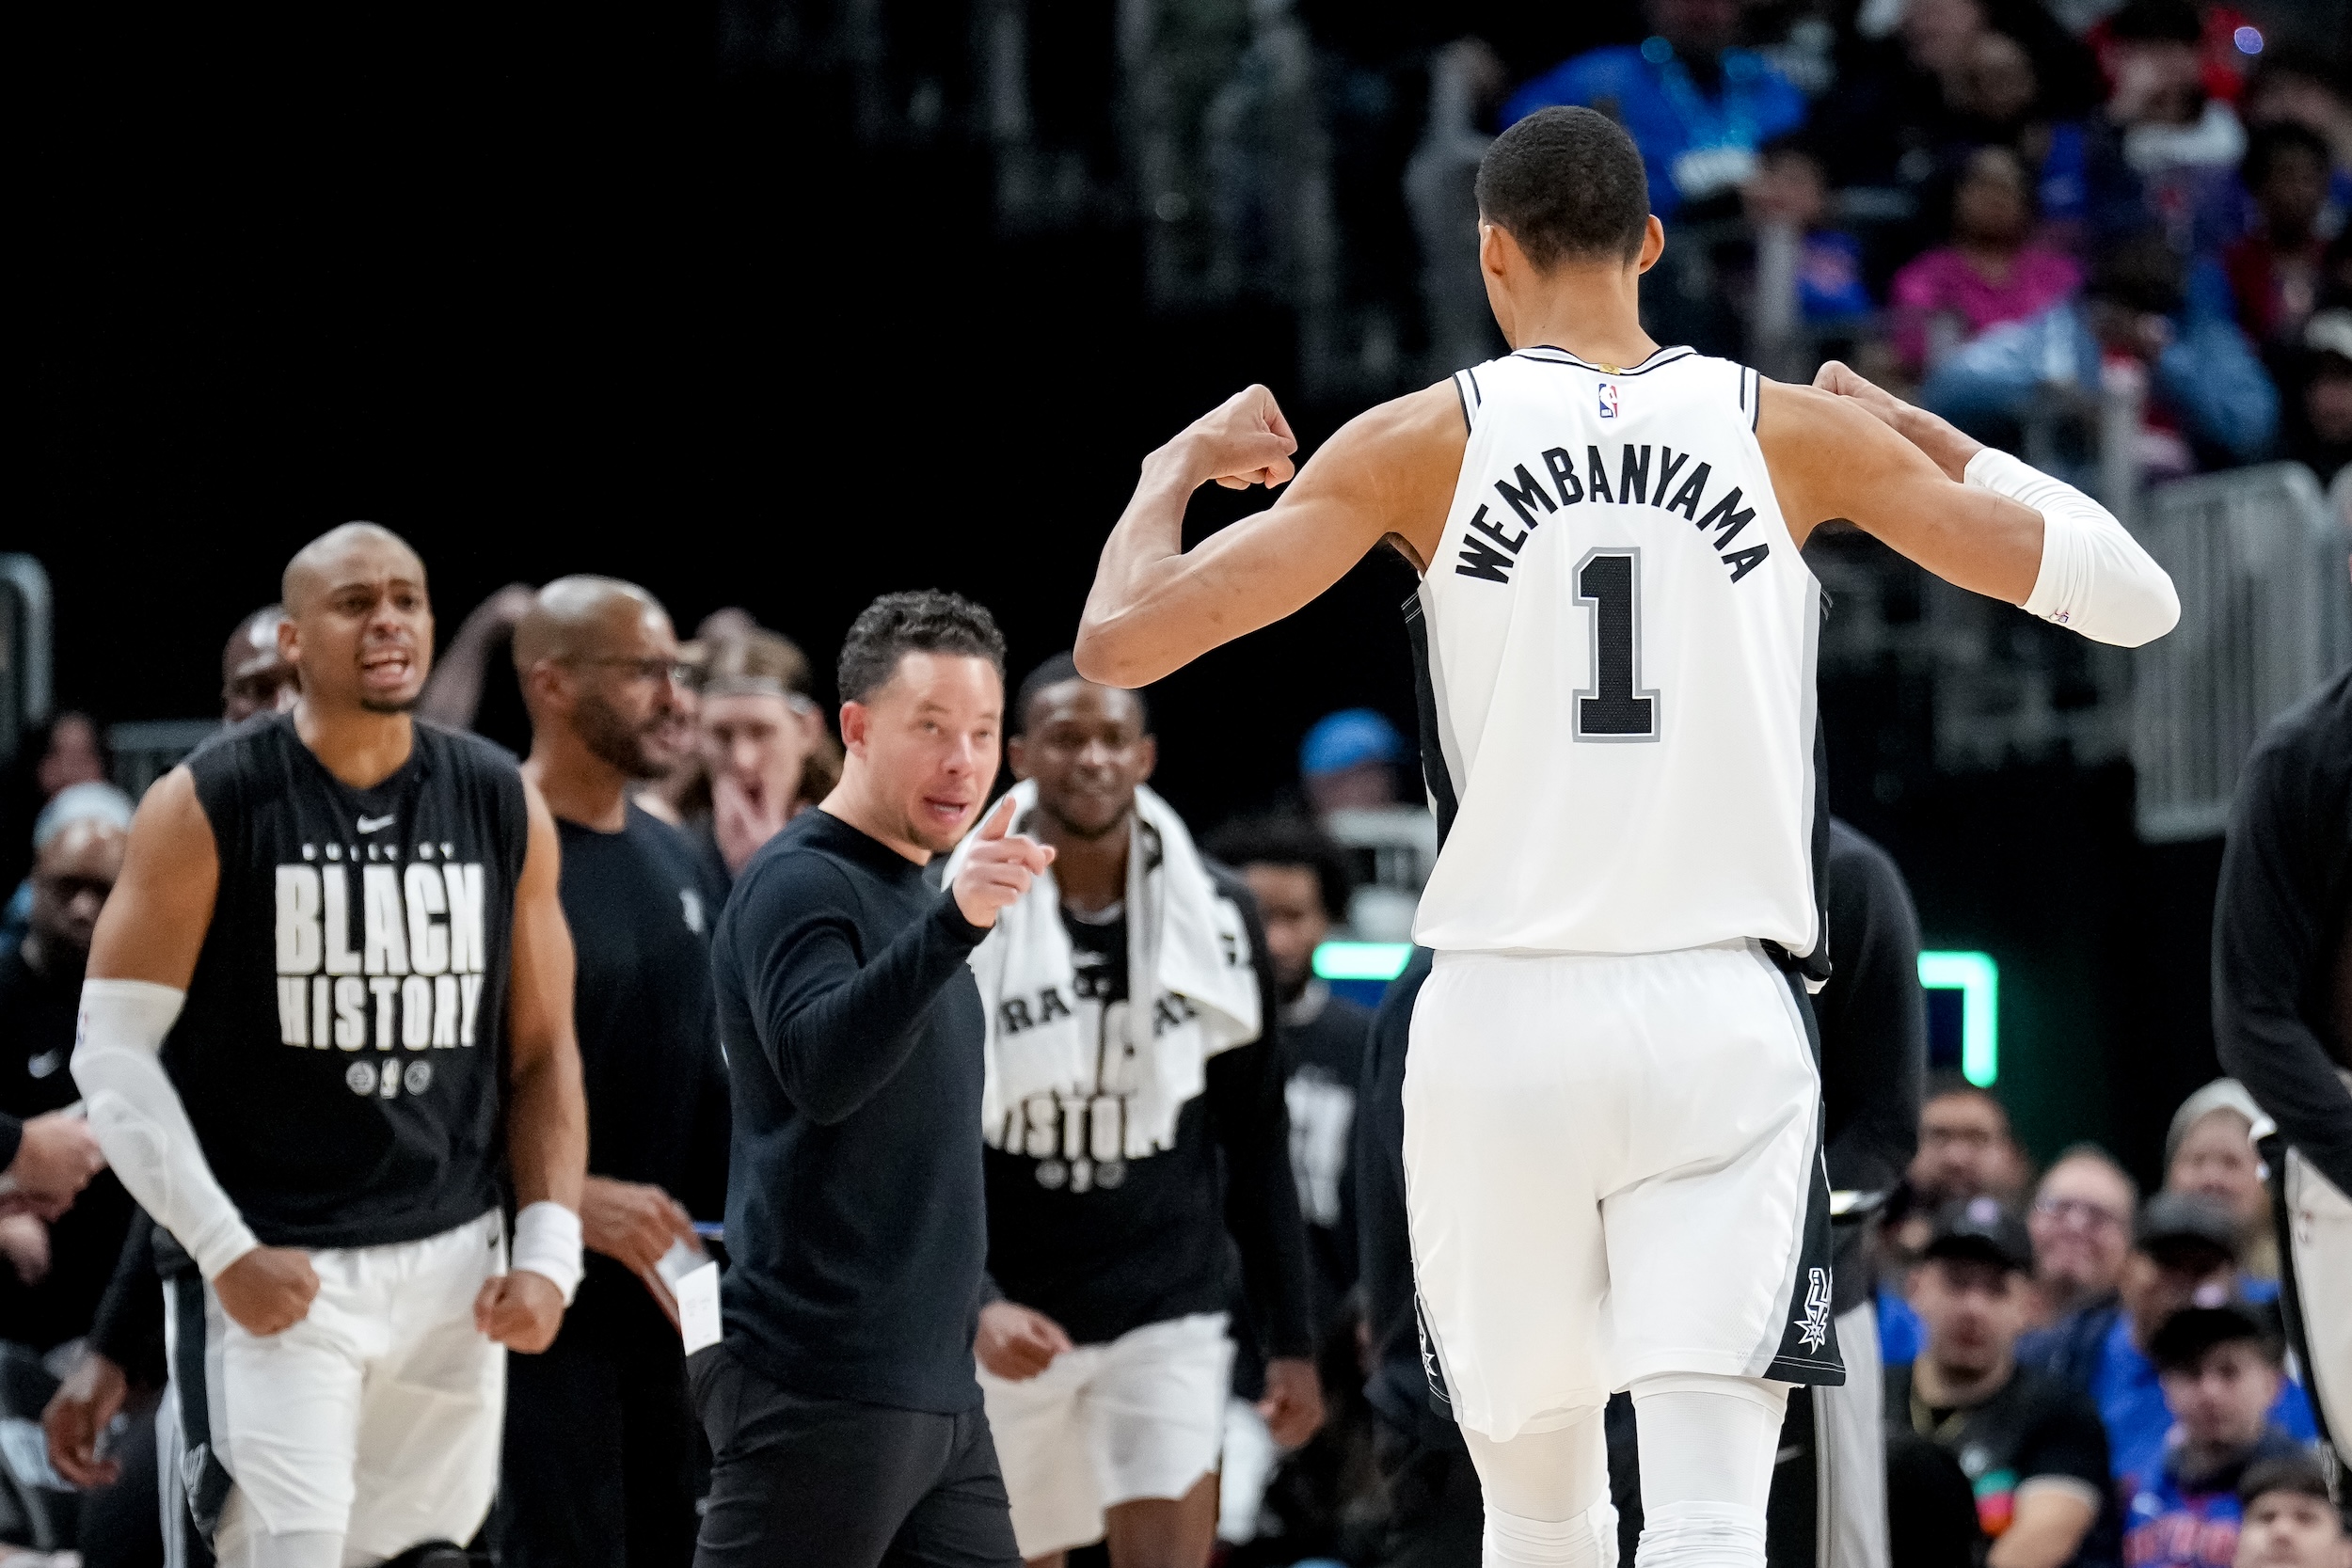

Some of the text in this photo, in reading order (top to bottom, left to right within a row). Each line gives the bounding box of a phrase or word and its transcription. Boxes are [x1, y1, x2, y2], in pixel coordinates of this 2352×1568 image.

[1455, 444, 1770, 584] WEMBANYAMA
[1572, 546, 1661, 743] 1
[276, 863, 484, 976] BLACK
[278, 974, 483, 1052] HISTORY
